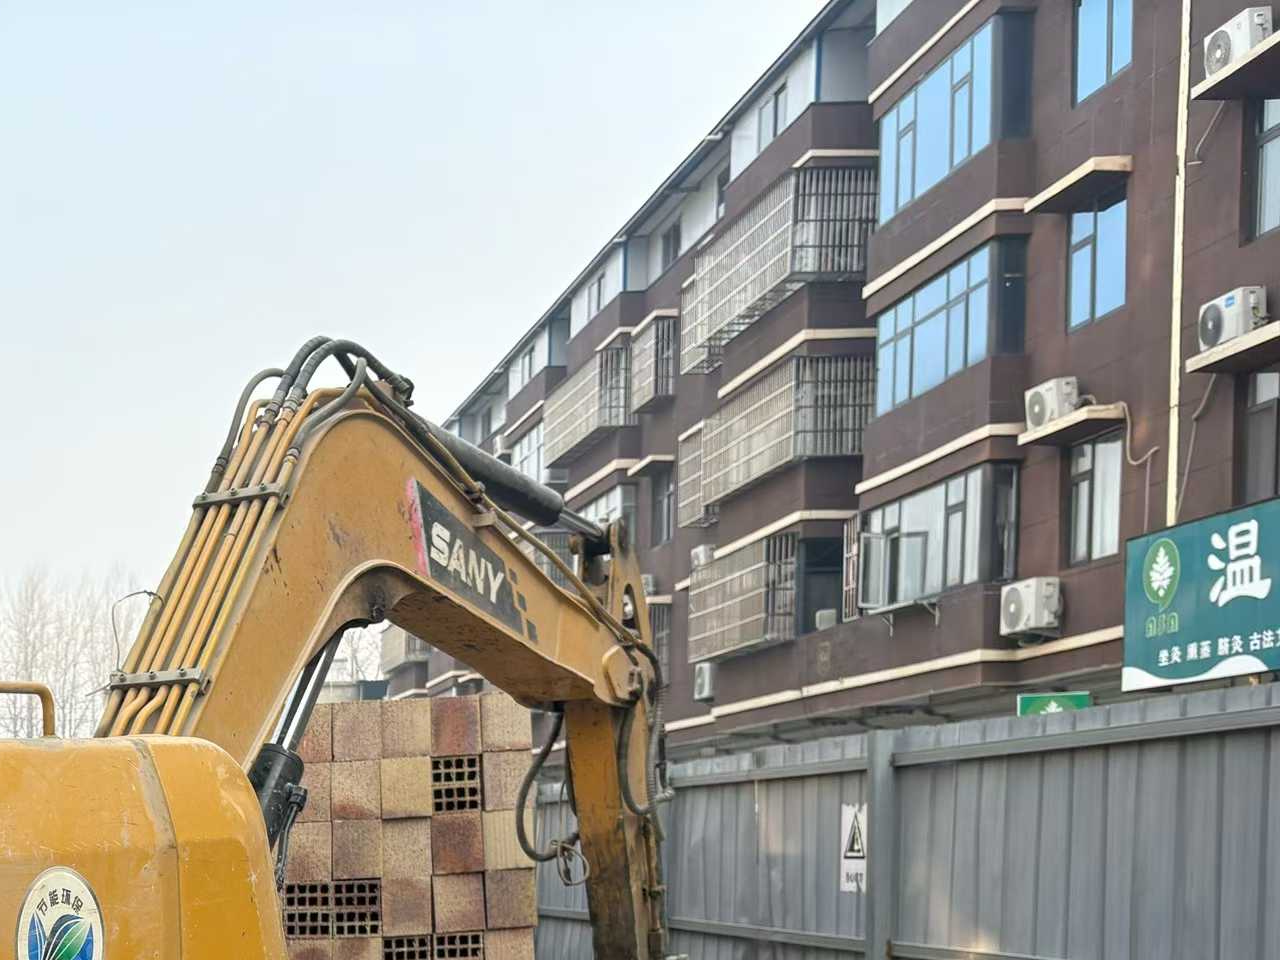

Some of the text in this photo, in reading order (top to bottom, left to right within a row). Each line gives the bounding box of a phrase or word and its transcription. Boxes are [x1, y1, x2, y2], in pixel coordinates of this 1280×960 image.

[430, 521, 505, 604] SANY
[1207, 519, 1272, 608] 温
[36, 887, 83, 915] 节能环保
